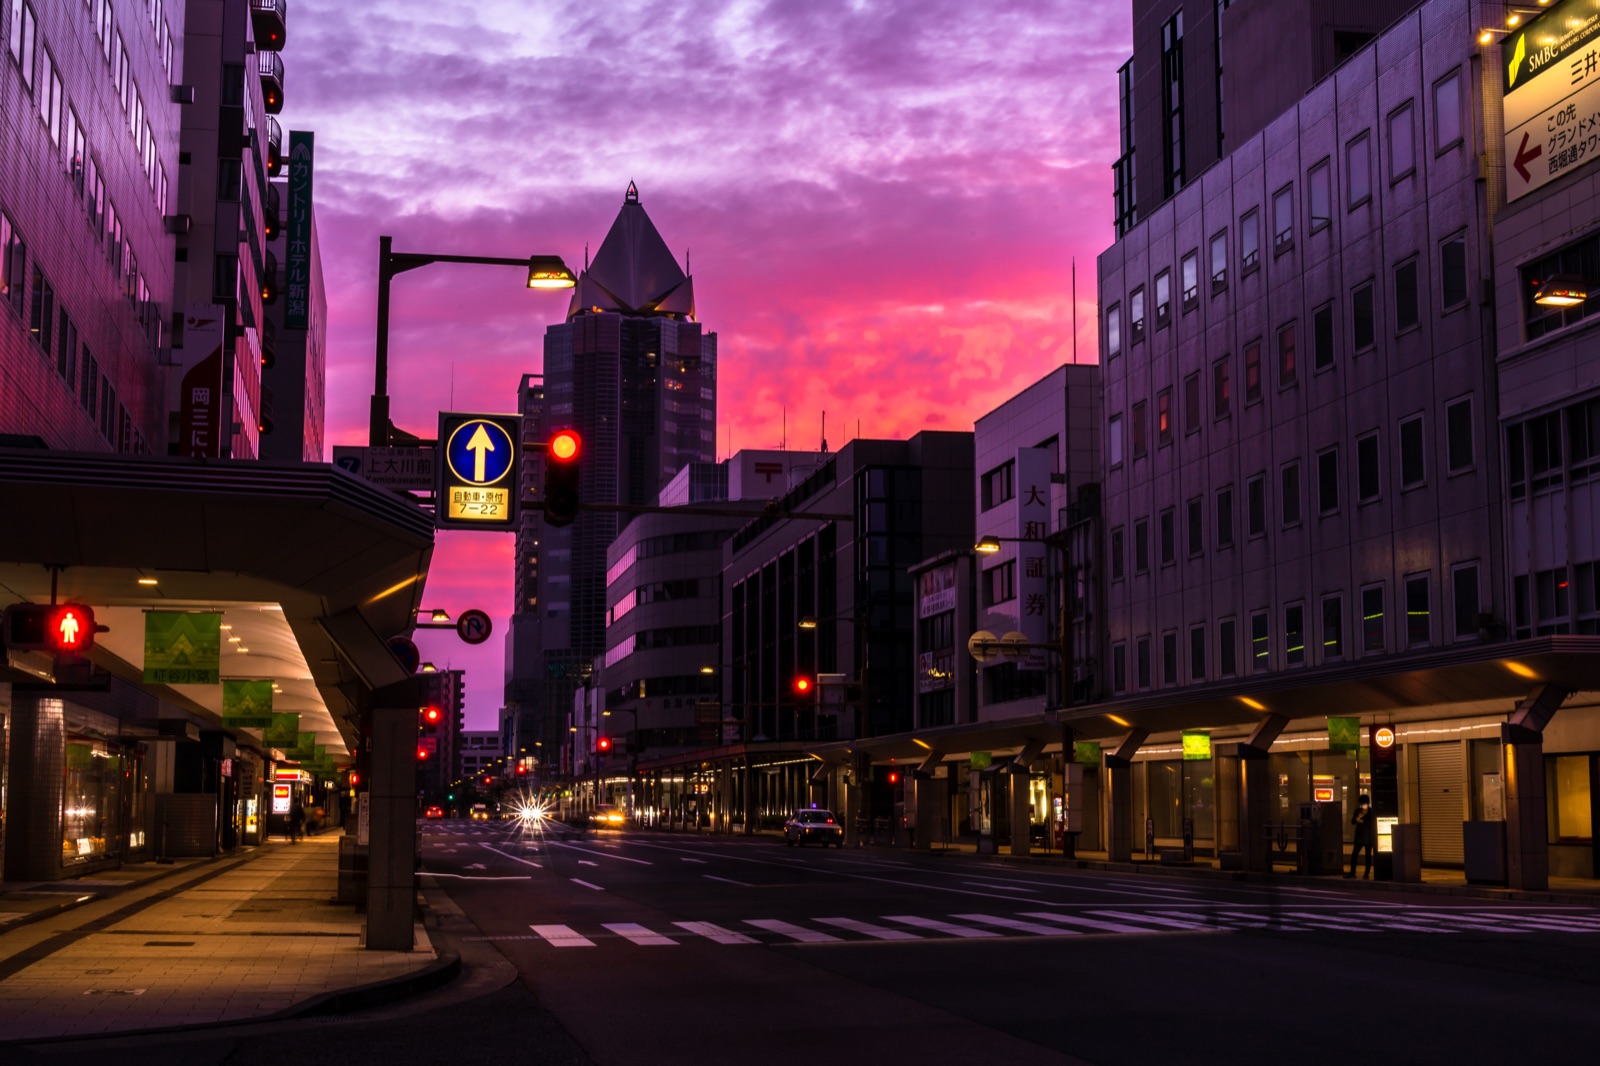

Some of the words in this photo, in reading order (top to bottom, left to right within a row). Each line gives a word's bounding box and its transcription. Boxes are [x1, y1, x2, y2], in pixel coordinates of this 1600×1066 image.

[1529, 41, 1558, 72] SMBC
[1571, 49, 1600, 85] 三井
[1548, 104, 1576, 132] この先
[1548, 134, 1600, 175] 西堀通タワ
[289, 162, 308, 317] カントリーホテル新潟
[366, 475, 432, 485] Kamiokawamae
[367, 458, 431, 474] 上大川前
[1024, 485, 1046, 616] 大和証券
